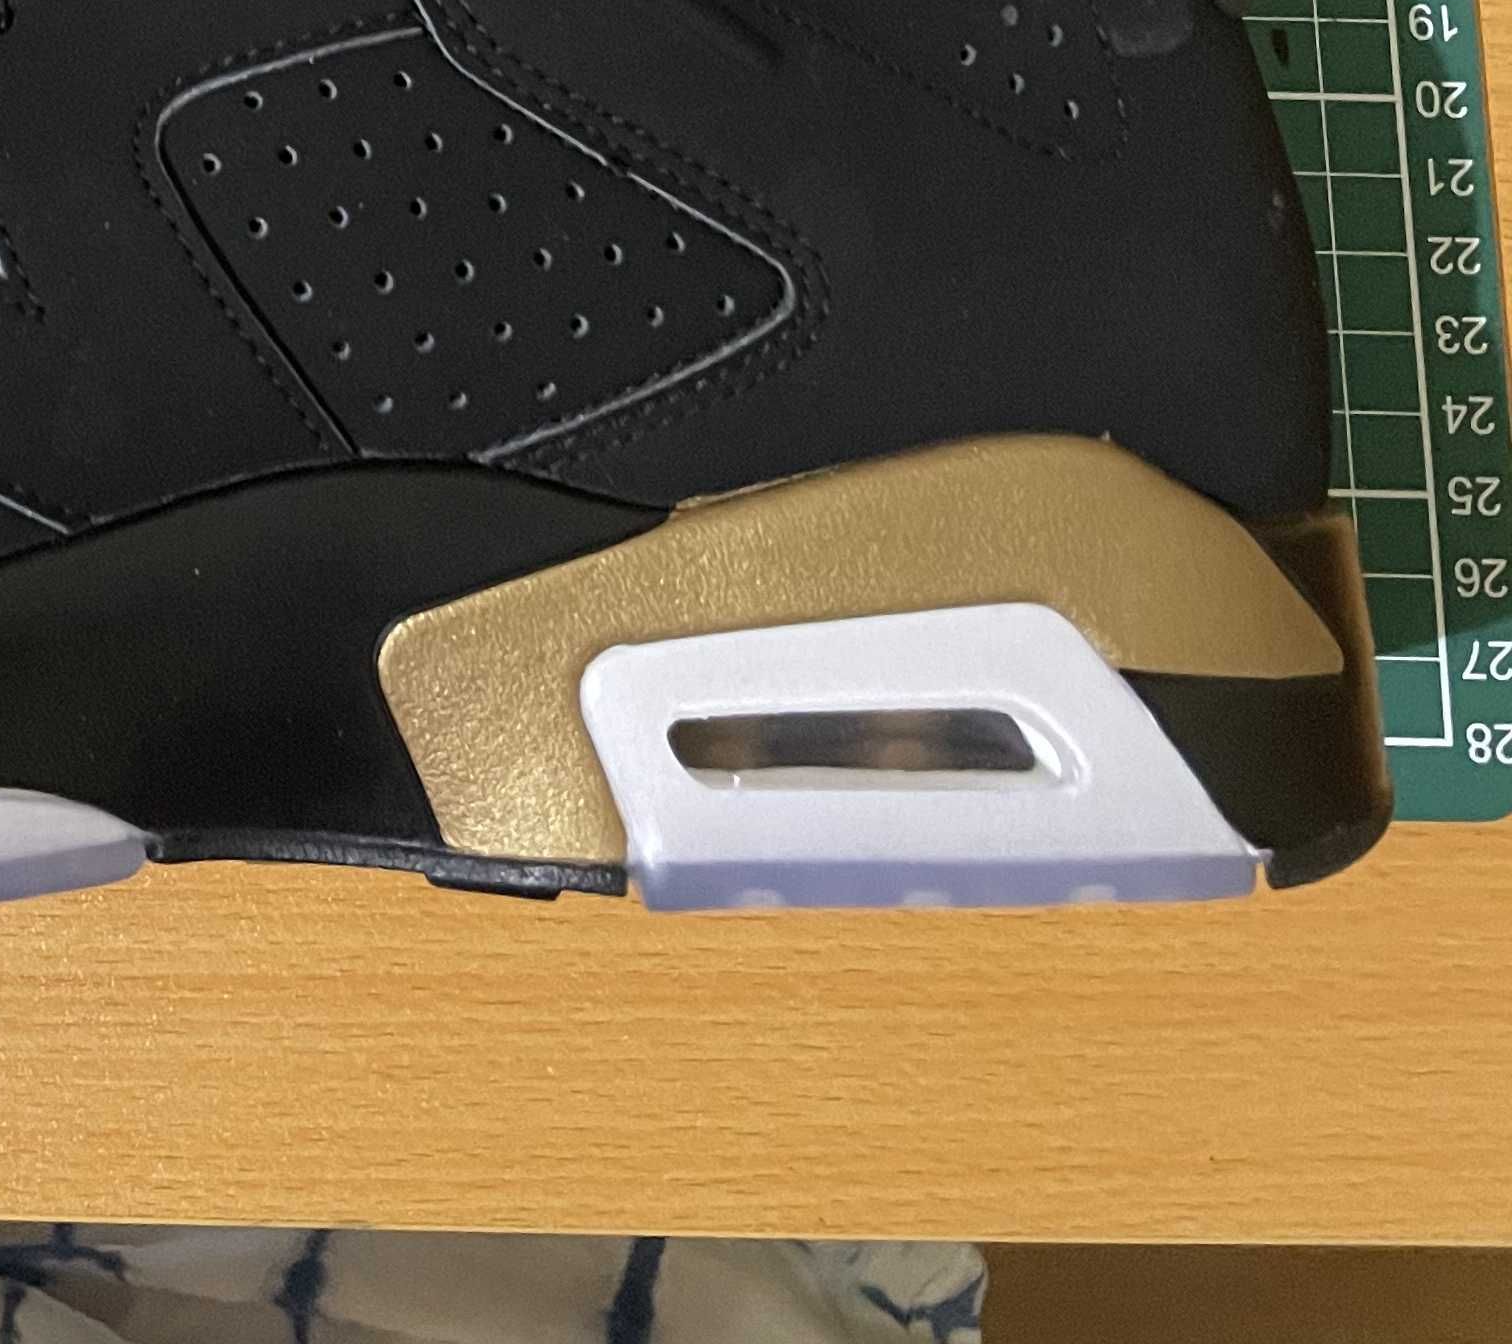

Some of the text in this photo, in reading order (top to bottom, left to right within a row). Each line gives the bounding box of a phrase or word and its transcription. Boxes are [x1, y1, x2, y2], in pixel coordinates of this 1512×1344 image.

[1408, 3, 1459, 43] 19
[1415, 80, 1469, 119] 20
[1427, 157, 1475, 197] 21
[1426, 236, 1482, 275] 22
[1434, 315, 1489, 355] 23
[1441, 395, 1496, 436] 24
[1447, 476, 1502, 517] 25
[1454, 557, 1509, 599] 26
[1461, 639, 1512, 681] 27
[1465, 722, 1512, 765] 28
